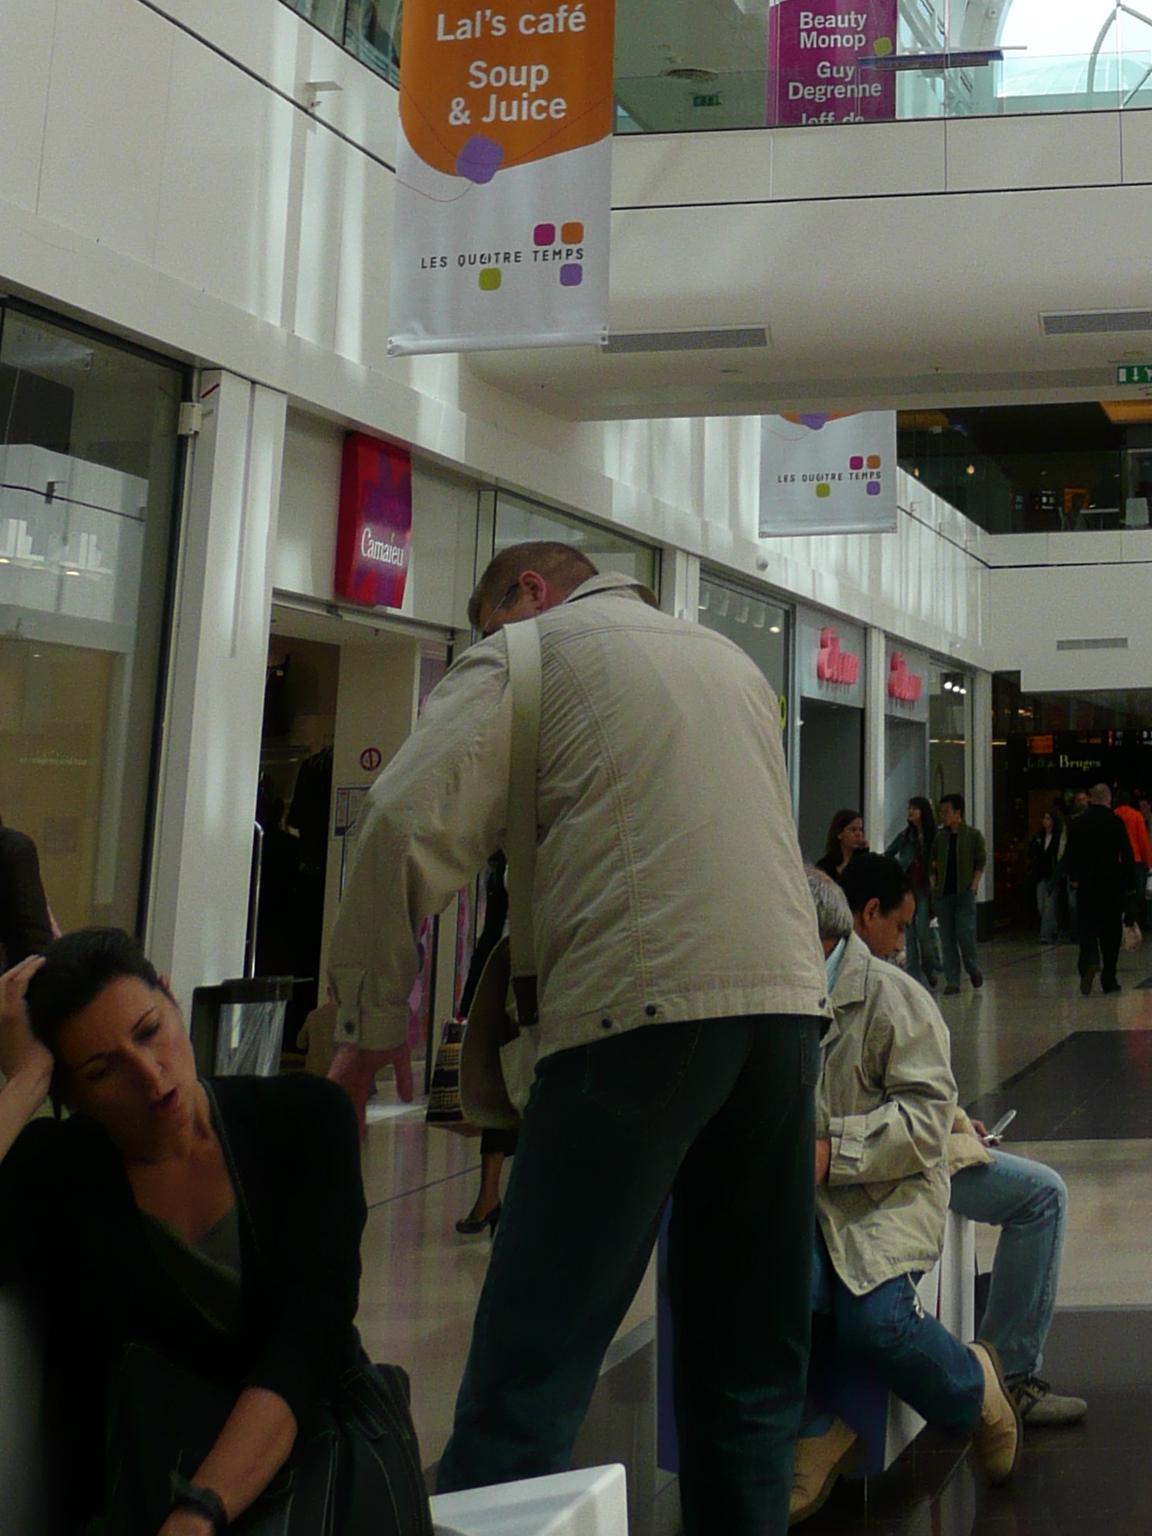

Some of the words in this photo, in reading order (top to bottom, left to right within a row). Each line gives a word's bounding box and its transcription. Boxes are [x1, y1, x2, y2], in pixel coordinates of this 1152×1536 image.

[436, 9, 508, 41] Lal's
[518, 4, 587, 37] café
[799, 11, 868, 31] Beauty
[799, 31, 867, 51] Monop
[468, 60, 550, 93] Soup
[816, 61, 856, 82] Guy
[788, 82, 883, 103] Degrenne
[448, 97, 472, 126] &
[481, 91, 568, 124] Juice
[420, 255, 448, 269] LES
[532, 248, 586, 263] TEMPS
[778, 474, 796, 483] LES
[849, 471, 882, 481] TEMPS
[1059, 754, 1101, 772] Bruges
